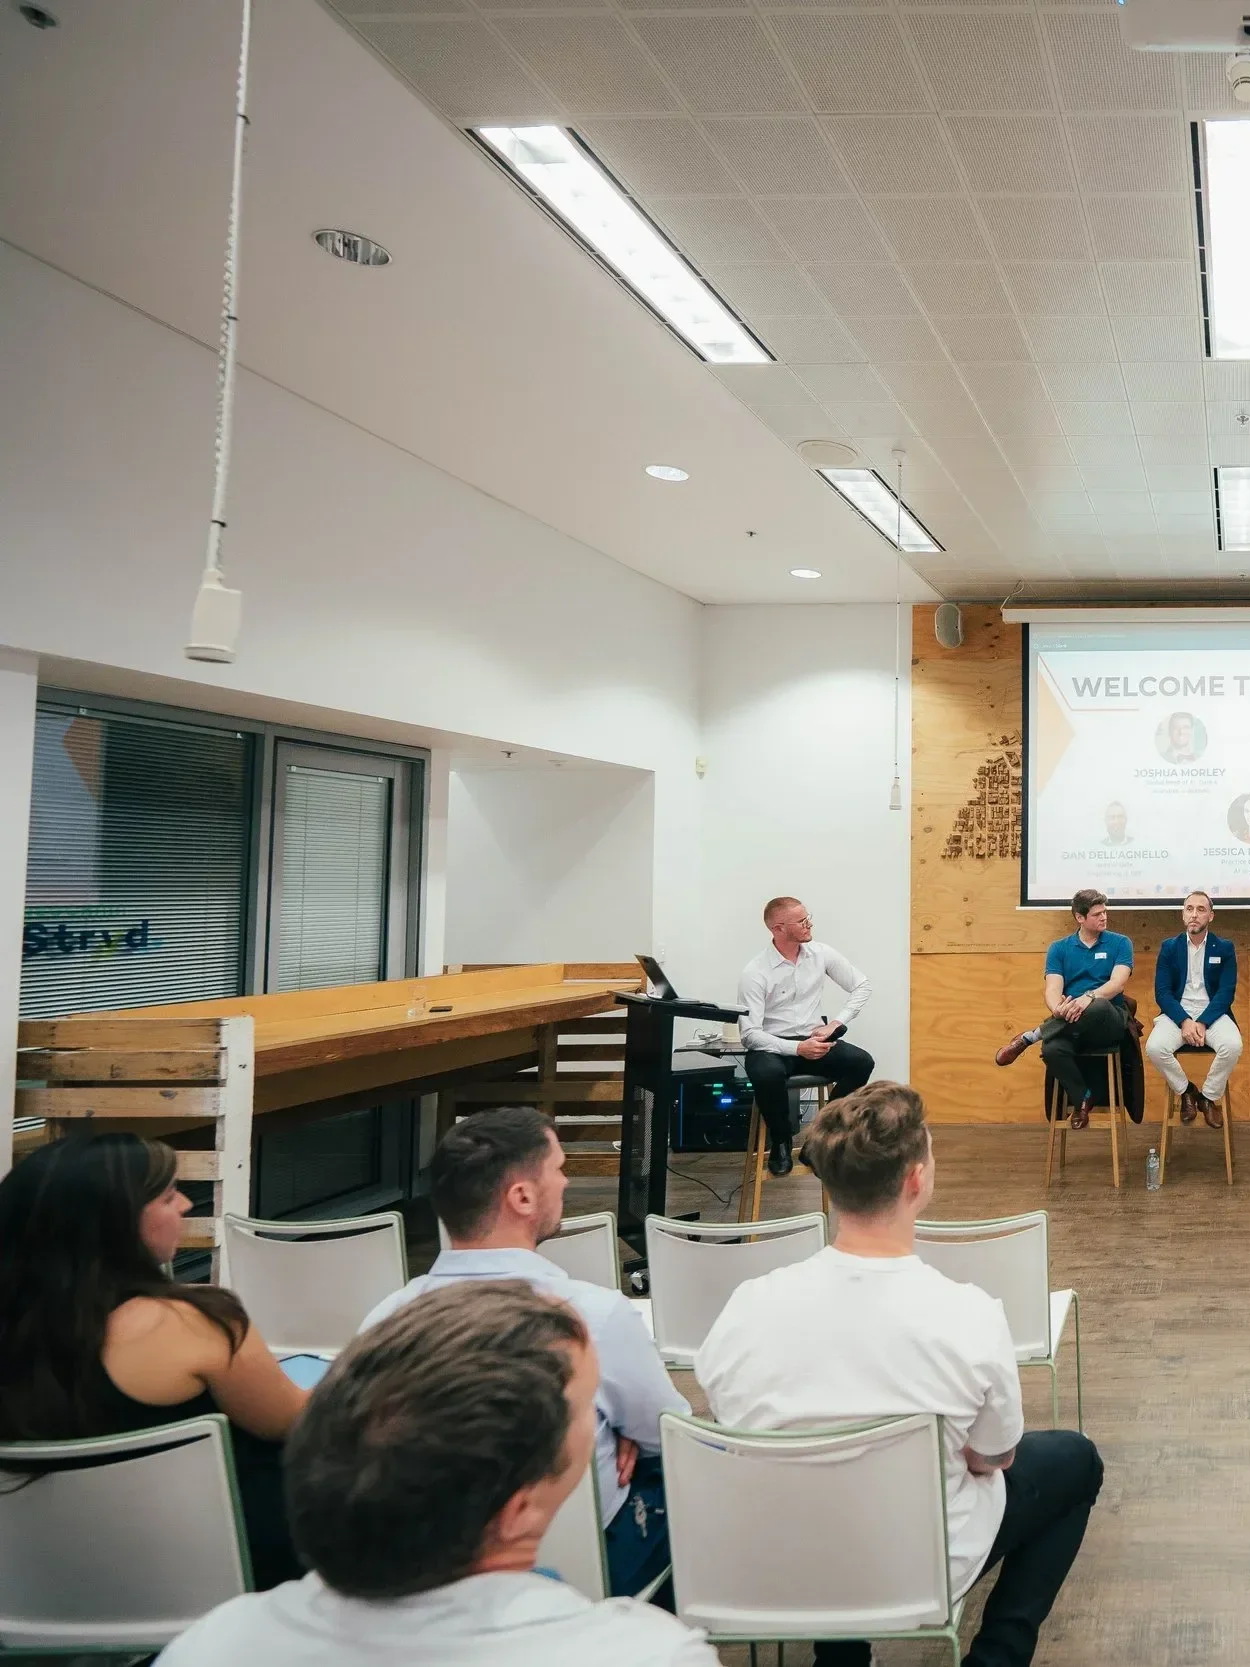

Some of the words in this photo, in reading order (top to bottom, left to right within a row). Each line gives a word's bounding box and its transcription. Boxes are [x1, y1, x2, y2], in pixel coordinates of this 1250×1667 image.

[1072, 676, 1225, 697] WELCOME
[1133, 768, 1178, 778] JOSHUA
[1181, 767, 1226, 777] MORLEY
[1061, 850, 1085, 860] DAN
[1088, 850, 1169, 859] DELL'AGNELLO
[1203, 847, 1245, 857] JESSICA
